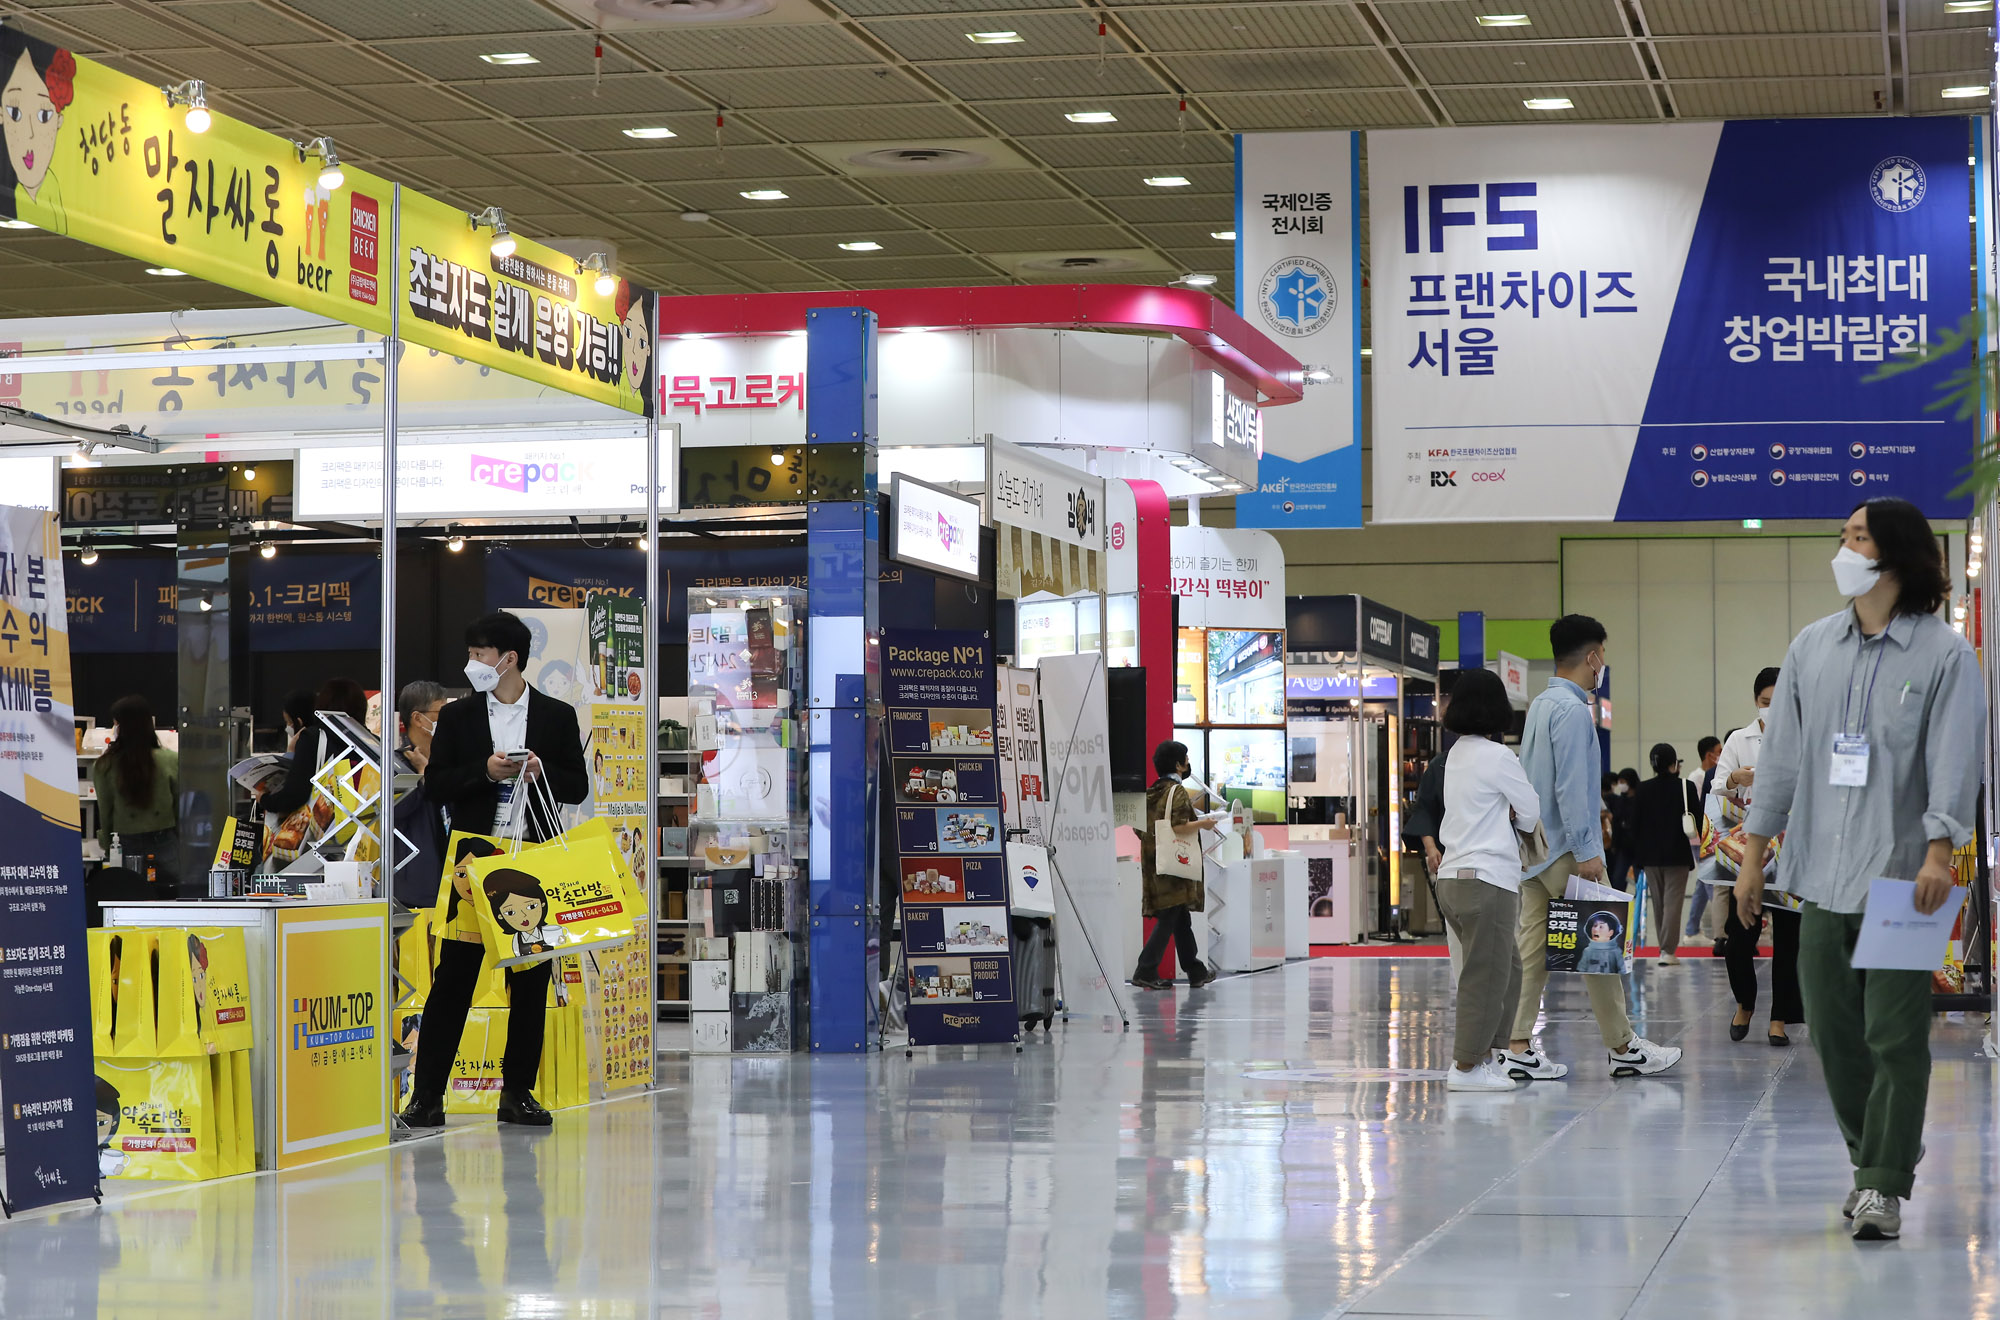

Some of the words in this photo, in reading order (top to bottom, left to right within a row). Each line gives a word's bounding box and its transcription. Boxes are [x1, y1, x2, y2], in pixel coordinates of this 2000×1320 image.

[79, 102, 132, 176] 청담동
[143, 129, 283, 279] 말자싸롱
[1262, 192, 1332, 213] 국제인증
[352, 207, 376, 232] CHICKEN
[1404, 181, 1539, 254] IFS
[1271, 215, 1324, 235] 전시회
[353, 236, 374, 259] BEER
[297, 245, 333, 293] beer
[1270, 259, 1305, 277] CERTIFIED
[1305, 261, 1334, 294] EXHIBITION
[1763, 253, 1929, 304] 국내최대
[1406, 269, 1638, 320] 프랜차이즈
[408, 247, 489, 333] 초보자도
[494, 281, 532, 350] 쉽게
[536, 296, 572, 360] 운영
[576, 311, 620, 377] 가능!!
[1723, 313, 1929, 365] 창업박람회
[1407, 327, 1499, 377] 서울
[1227, 394, 1256, 453] 삼진어묵
[1428, 449, 1449, 457] KFA
[1662, 447, 1676, 456] 후원
[1710, 447, 1755, 456] 산업통상자원부
[474, 462, 595, 492] crepack
[1430, 471, 1457, 487] RX
[1471, 469, 1506, 482] coex
[997, 470, 1020, 508] 오늘도
[1261, 480, 1286, 493] AKEI
[1200, 557, 1232, 571] 즐기는
[1236, 558, 1258, 572] 한끼
[326, 611, 352, 622] 시스템
[888, 646, 950, 666] Package
[890, 667, 984, 680] www.crepack.co.kr
[893, 711, 922, 721] FRANCHISE
[921, 742, 929, 750] 01
[958, 763, 983, 771] CHICKEN
[960, 793, 967, 801] 02
[900, 812, 914, 820] TRAY
[929, 842, 937, 850] 03
[965, 862, 982, 870] PIZZA
[545, 881, 602, 907] 약속다방
[967, 891, 975, 899] 04
[907, 912, 929, 921] BAKERY
[1549, 920, 1577, 930] 우주로
[937, 942, 945, 950] 05
[1548, 932, 1577, 949] 떡상
[53, 945, 65, 959] 운영
[973, 961, 999, 970] ORDERED
[974, 971, 999, 980] PRODUCT
[975, 991, 983, 1000] 06
[309, 992, 373, 1031] KUM-TOP
[944, 1015, 980, 1028] crepack
[310, 1033, 342, 1045] KUM-TOP
[122, 1106, 183, 1134] 약속다방
